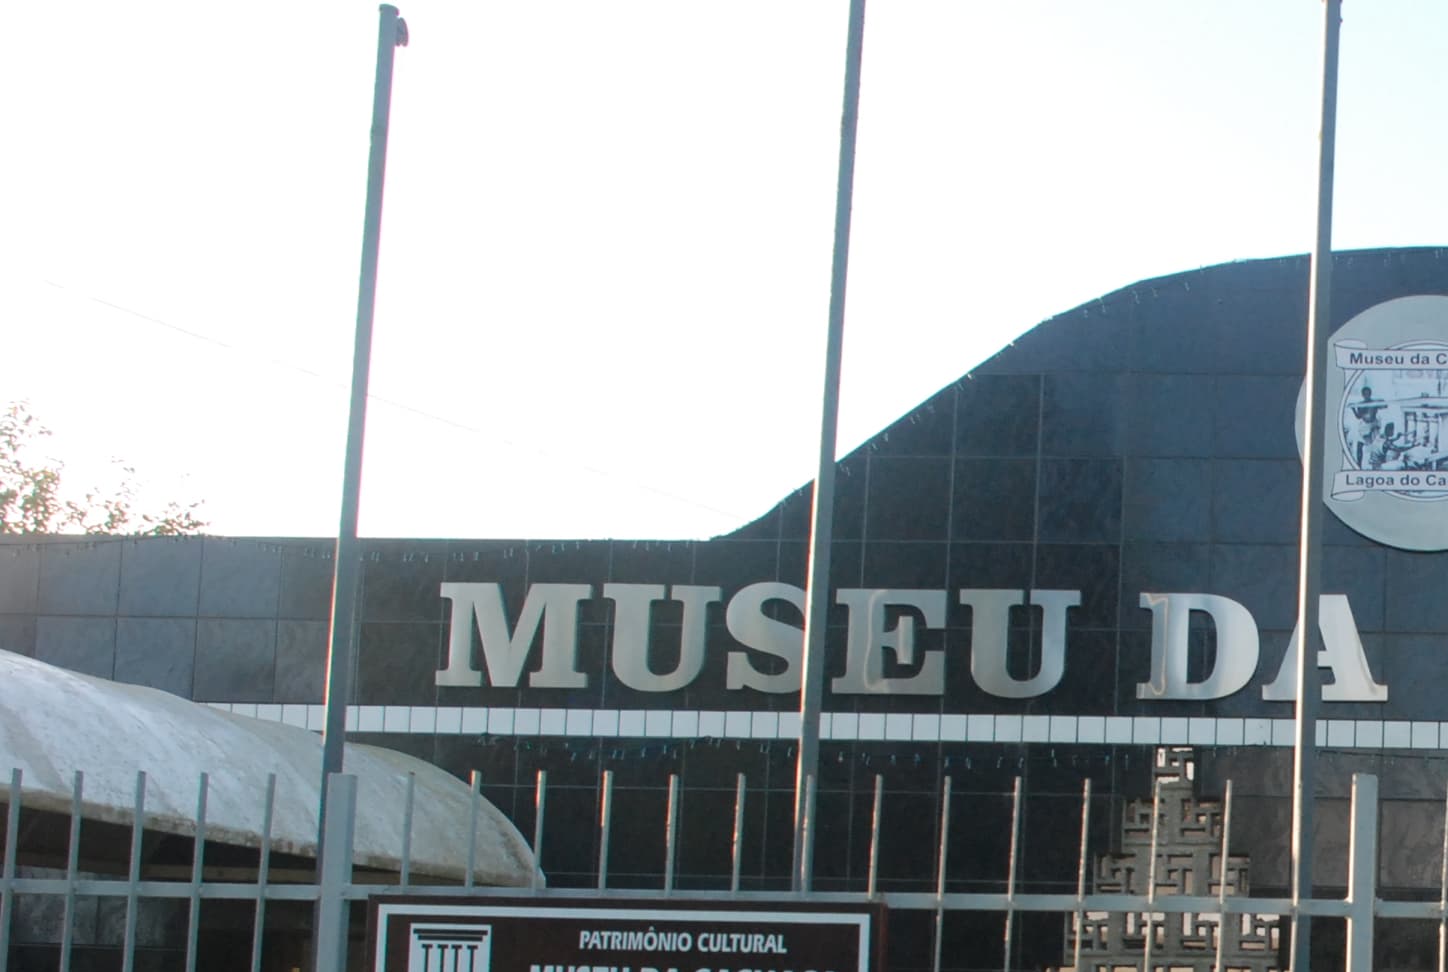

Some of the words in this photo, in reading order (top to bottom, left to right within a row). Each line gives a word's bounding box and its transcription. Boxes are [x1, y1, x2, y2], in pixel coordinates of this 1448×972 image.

[1350, 353, 1404, 365] Museu
[1410, 353, 1430, 365] da
[1345, 474, 1394, 489] Lagoa
[1400, 474, 1420, 486] do
[434, 580, 1081, 698] MUSEU
[1136, 591, 1389, 703] DA
[578, 926, 692, 952] PATRIMÔNIO
[697, 932, 787, 954] CULTURAL
